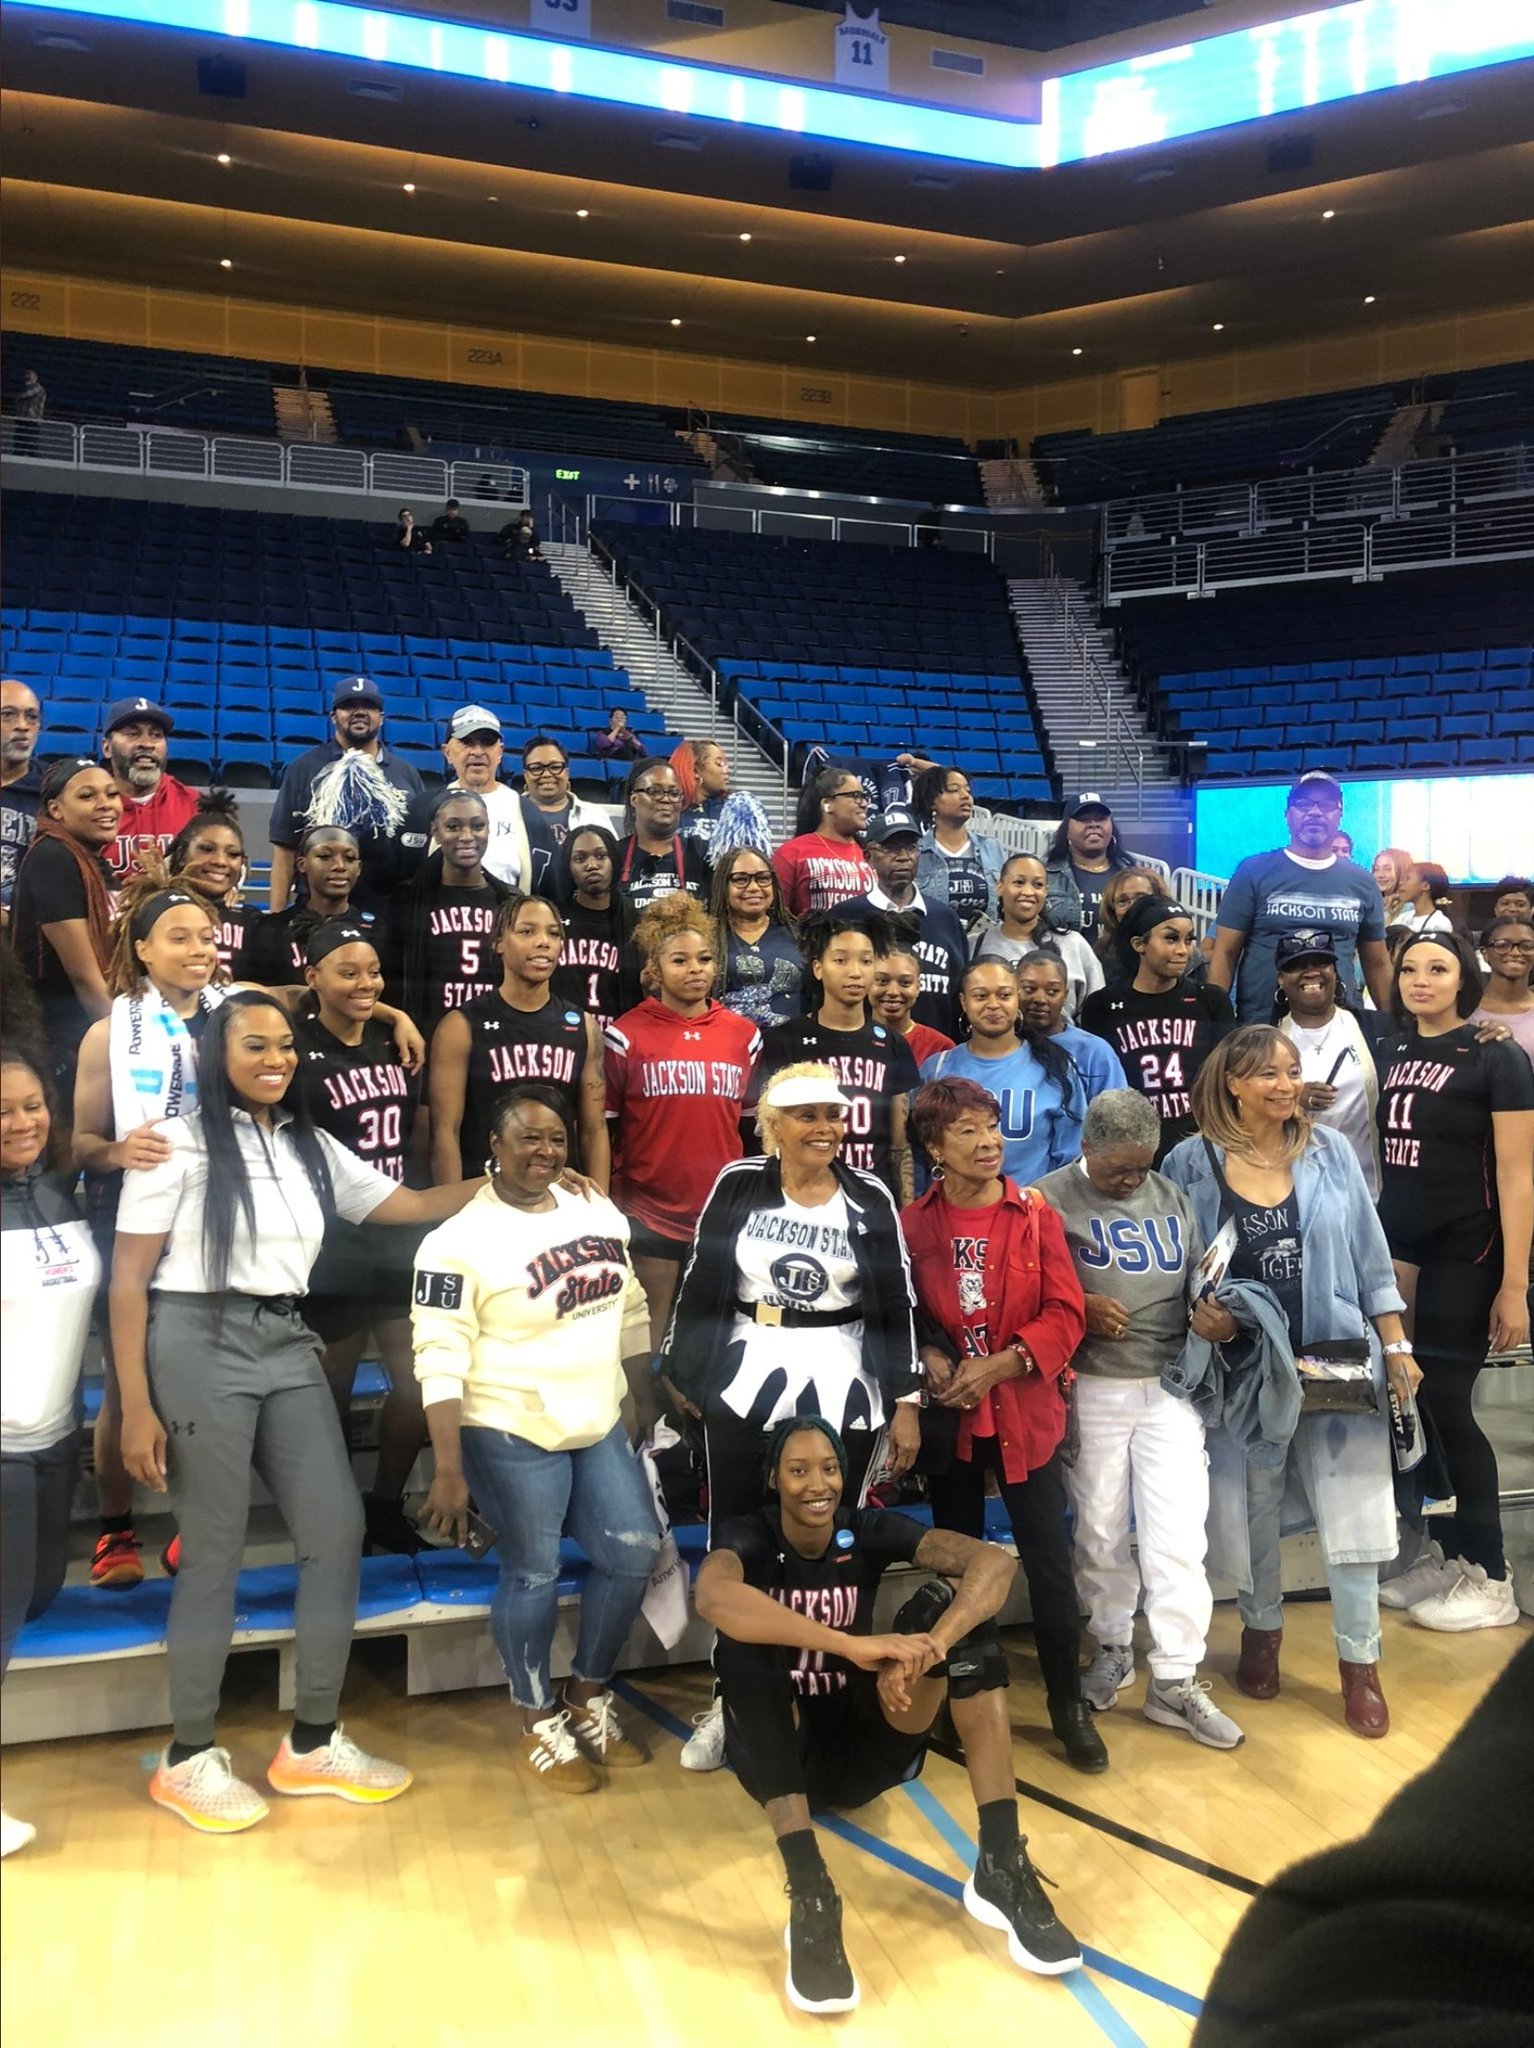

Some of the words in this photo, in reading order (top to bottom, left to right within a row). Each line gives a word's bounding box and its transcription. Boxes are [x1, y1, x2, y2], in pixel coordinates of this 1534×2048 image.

[851, 40, 873, 65] 11
[11, 291, 40, 311] 222
[555, 469, 580, 480] EXIT
[352, 678, 365, 692] J
[135, 698, 148, 711] J
[106, 834, 174, 873] JS
[1266, 903, 1327, 920] JACKSON
[1331, 908, 1361, 924] STATE
[461, 939, 480, 974] 5
[558, 938, 620, 972] JACKSO
[587, 973, 600, 1007] 1
[919, 973, 949, 994] SITY
[1115, 1017, 1198, 1054] JACKSON
[489, 1044, 576, 1083] JACKSON
[641, 1061, 706, 1098] JACKSON
[711, 1061, 743, 1099] STATE
[1140, 1051, 1184, 1089] 24
[1383, 1058, 1456, 1093] JACKSON
[323, 1063, 408, 1110] JACKSON
[357, 1104, 401, 1150] 30
[1386, 1093, 1414, 1129] 11
[1383, 1137, 1421, 1168] STATE
[746, 1212, 821, 1247] JACKSON
[819, 1223, 856, 1261] STA
[1078, 1214, 1184, 1275] JSU
[525, 1234, 630, 1299] JACKSON
[554, 1267, 625, 1319] State
[571, 1299, 619, 1322] UNIVERSITY
